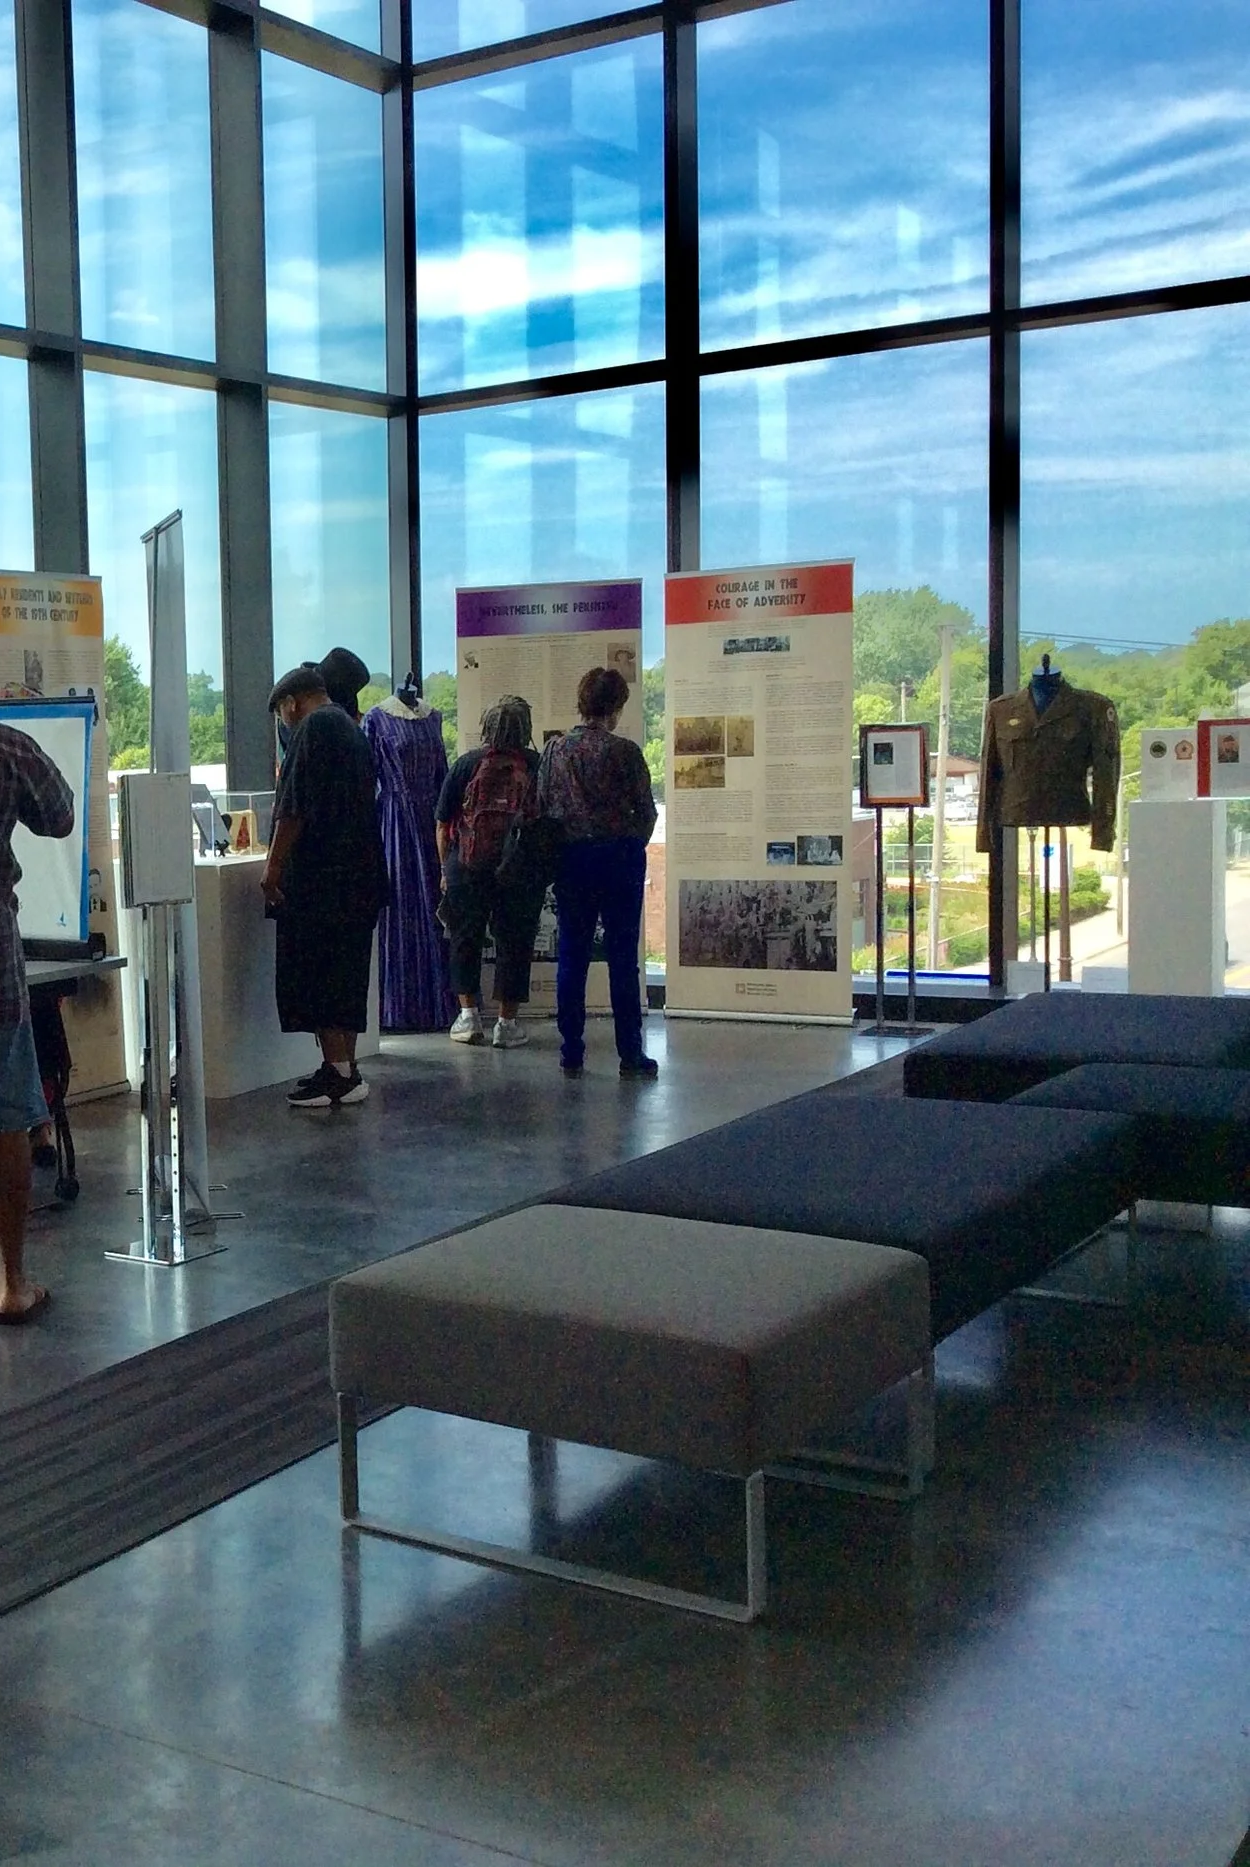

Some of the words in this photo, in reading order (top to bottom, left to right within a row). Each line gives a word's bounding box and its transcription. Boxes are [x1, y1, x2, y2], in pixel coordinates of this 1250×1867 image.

[716, 581, 760, 594] COURAGE
[764, 580, 775, 591] IN
[780, 578, 799, 590] THE
[47, 591, 63, 604] AND
[707, 598, 731, 611] FACE
[735, 597, 749, 609] OF
[754, 594, 806, 608] ADVERSITY
[2, 607, 11, 619] OF
[15, 608, 28, 621] THE
[31, 609, 48, 621] 19TH
[49, 610, 79, 623] CENTURY
[552, 603, 569, 615] SHE
